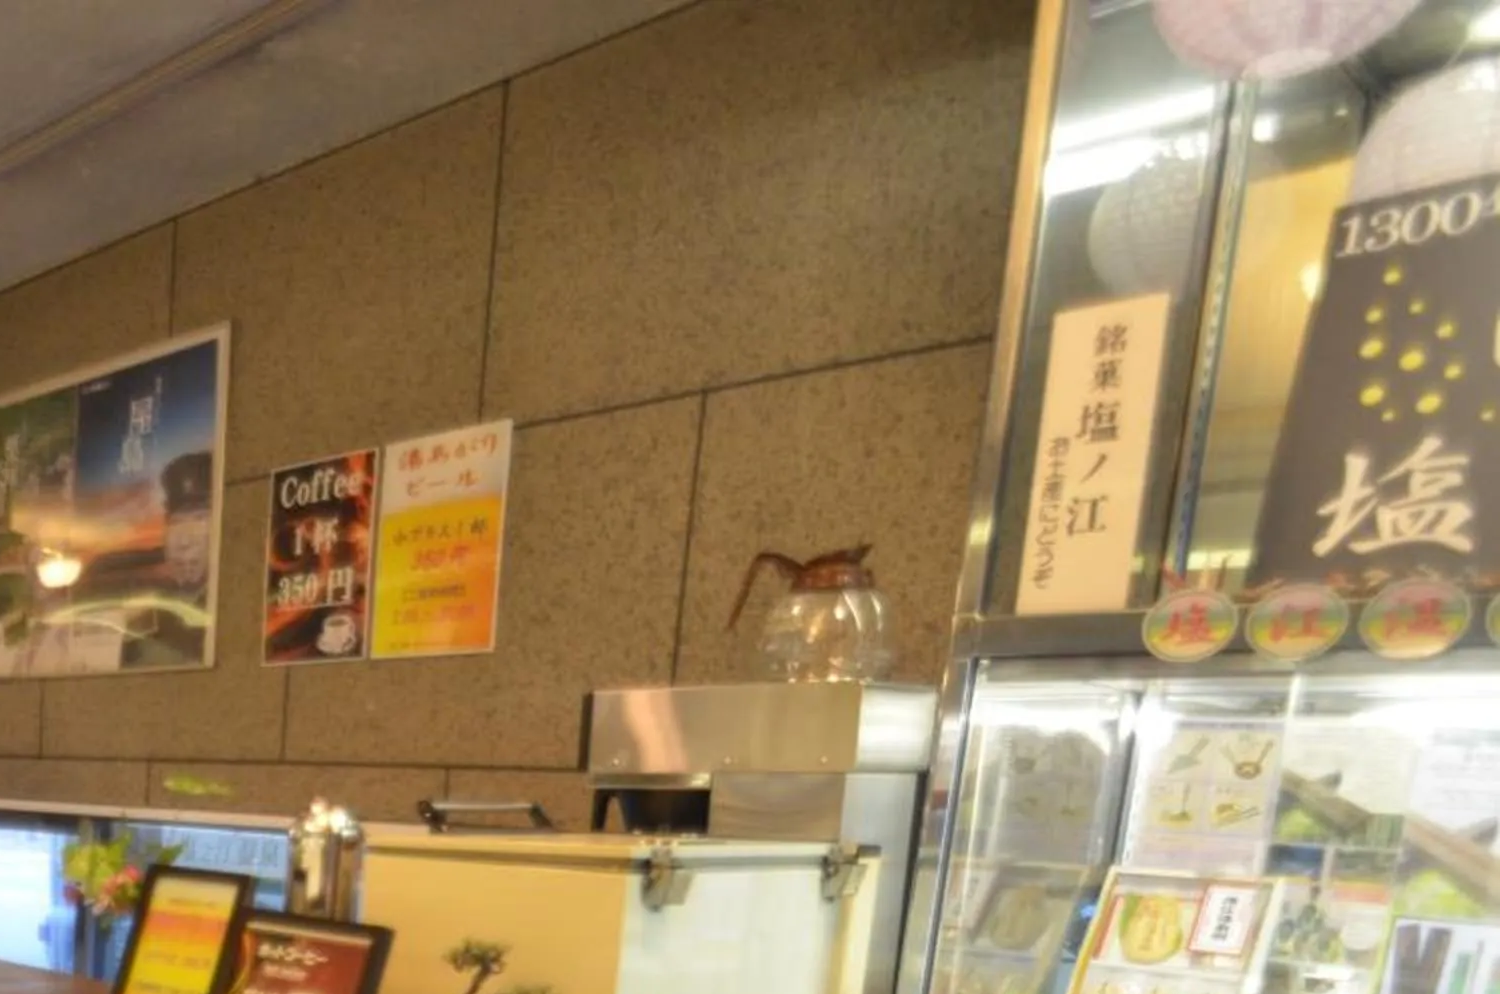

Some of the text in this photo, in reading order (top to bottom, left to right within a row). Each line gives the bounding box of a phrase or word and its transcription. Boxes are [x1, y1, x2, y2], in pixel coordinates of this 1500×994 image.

[1334, 187, 1500, 259] 1300
[280, 466, 364, 509] Coffee
[1311, 435, 1475, 559] 塩
